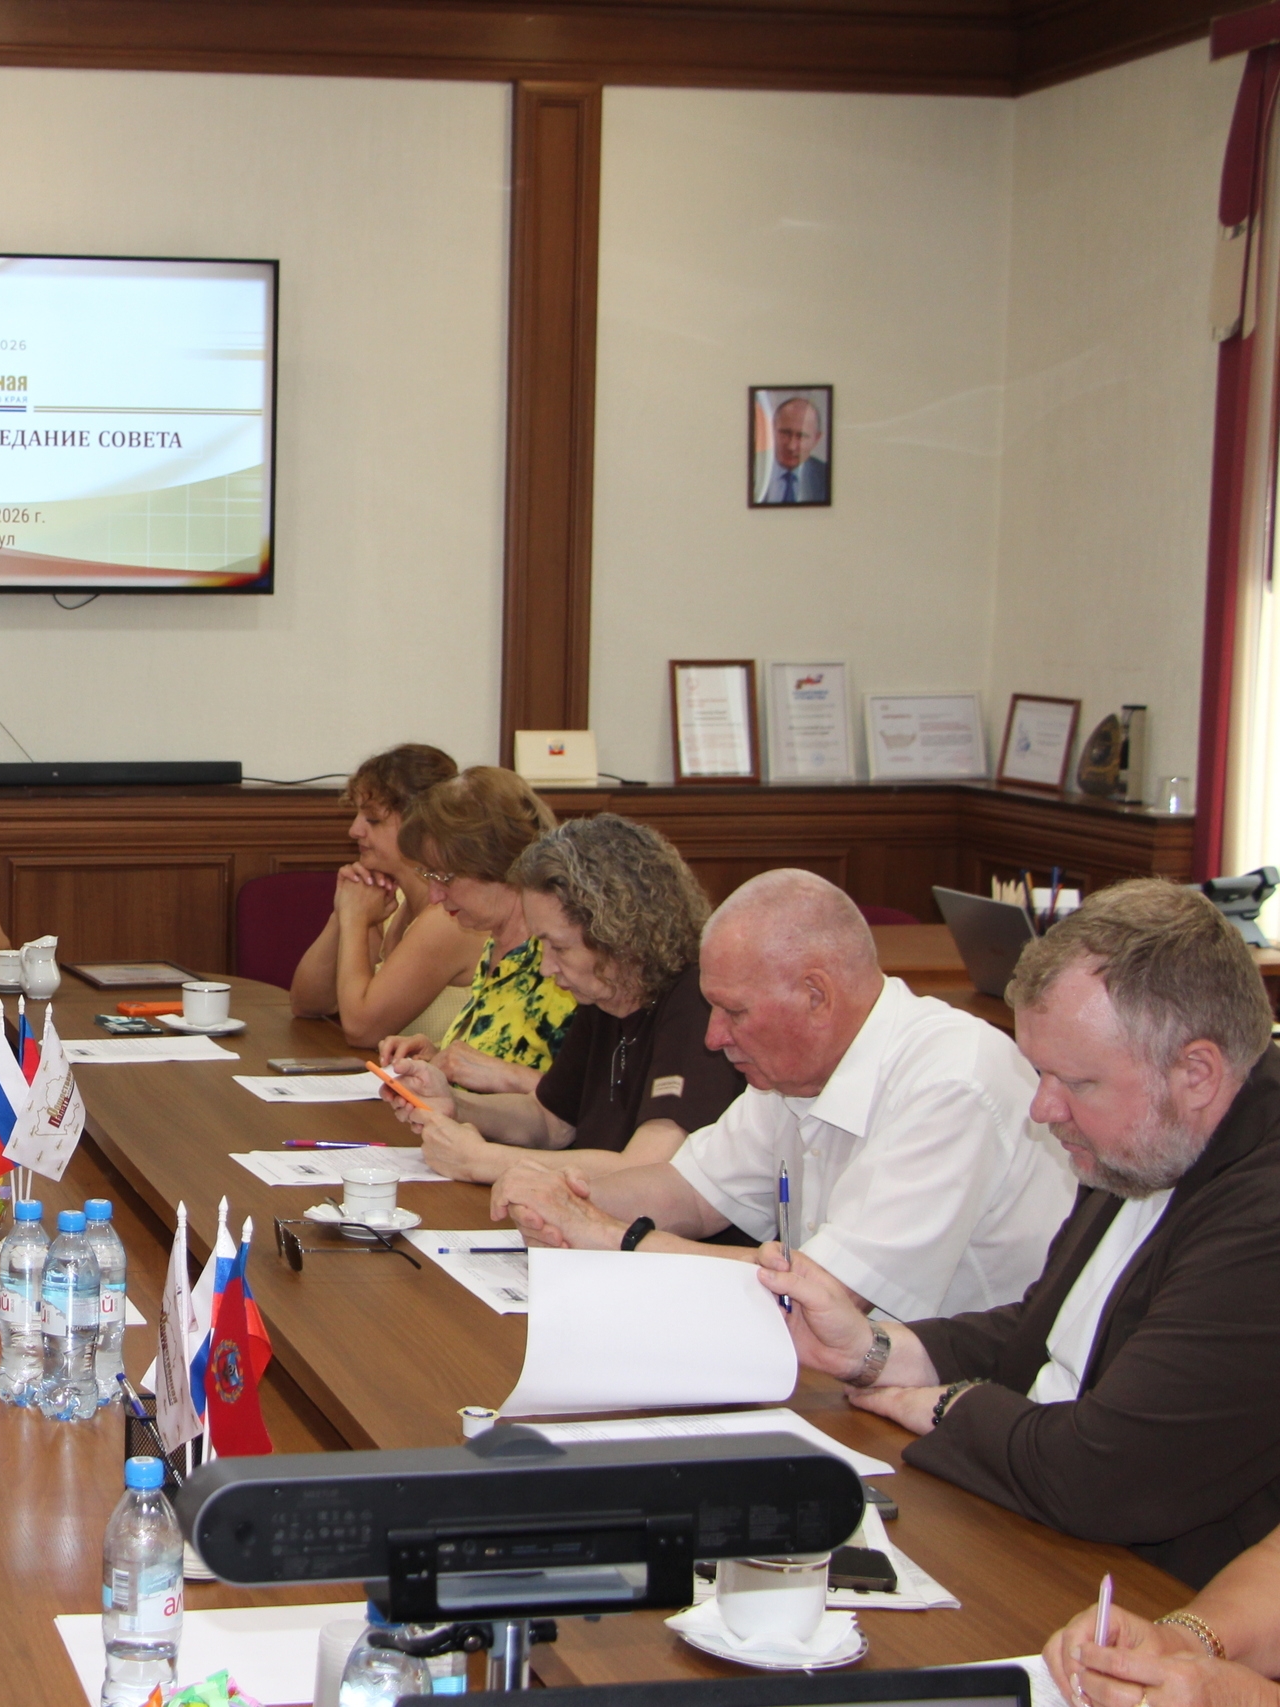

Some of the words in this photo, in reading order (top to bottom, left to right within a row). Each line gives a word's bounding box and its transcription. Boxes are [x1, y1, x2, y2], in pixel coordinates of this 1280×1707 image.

[5, 395, 28, 404] КРАЯ
[98, 430, 183, 449] СОВЕТА
[35, 511, 46, 523] г.
